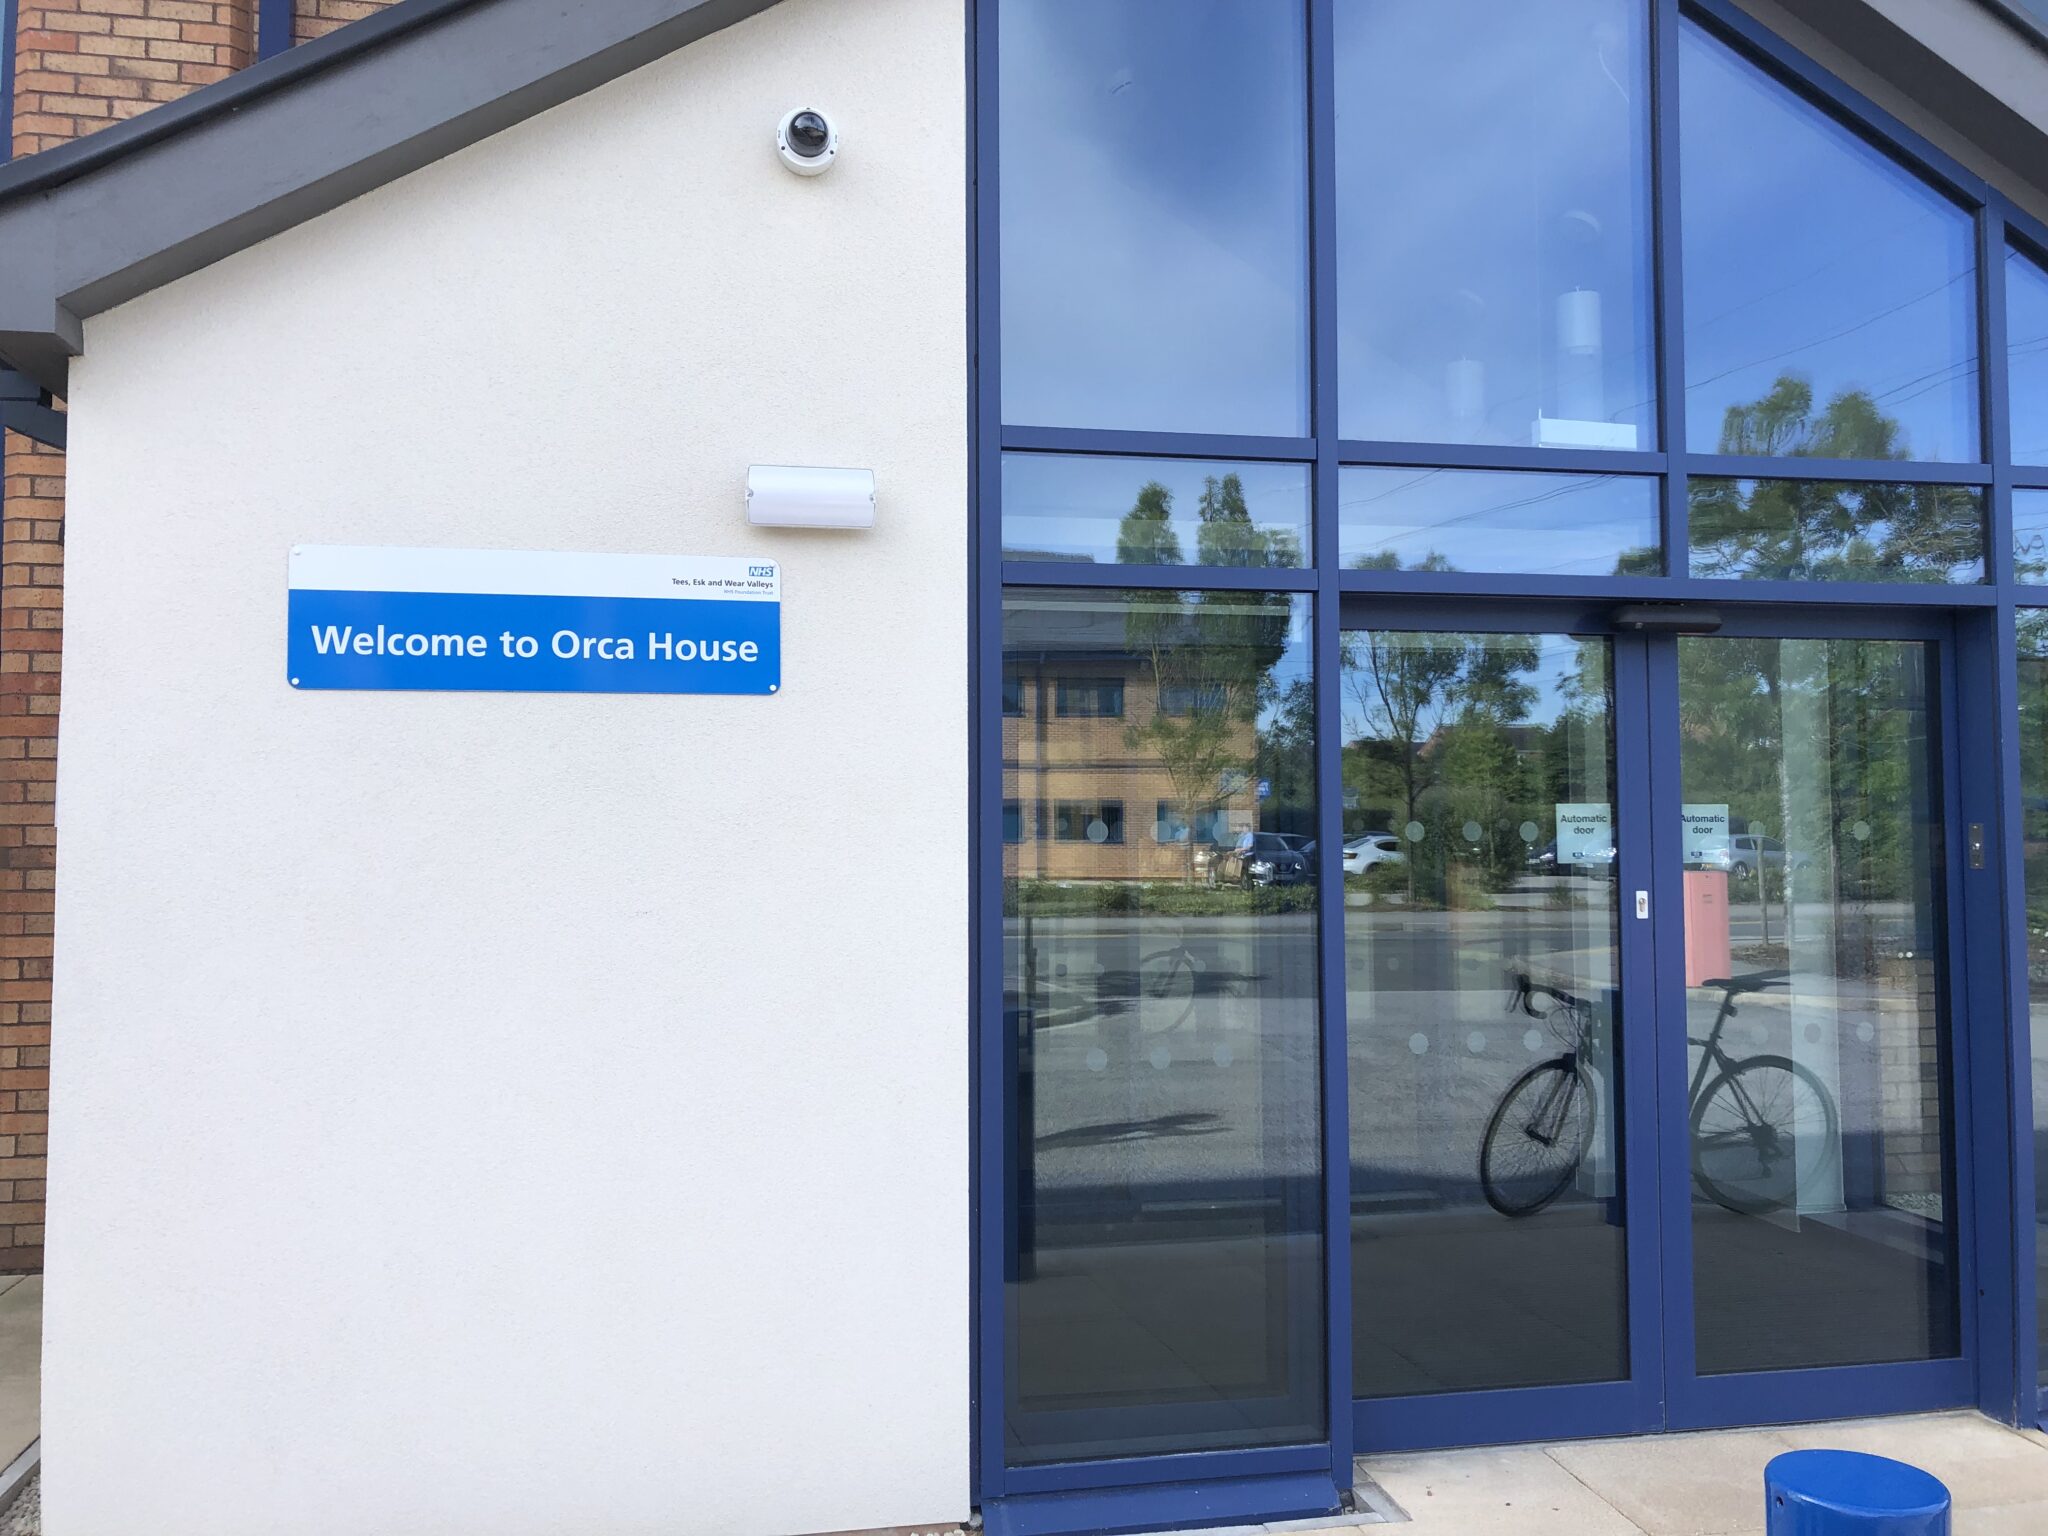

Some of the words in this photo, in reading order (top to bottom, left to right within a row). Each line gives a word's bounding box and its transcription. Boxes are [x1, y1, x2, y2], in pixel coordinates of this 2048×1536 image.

[749, 567, 773, 577] NHS
[672, 578, 691, 586] Tees,
[692, 578, 706, 586] Esk
[707, 579, 722, 587] and
[747, 580, 774, 589] Valleys
[311, 624, 488, 658] Welcome
[499, 631, 539, 659] to
[551, 629, 635, 660] Orca
[648, 632, 759, 662] House
[1560, 815, 1608, 823] Automatic
[1573, 826, 1595, 834] door
[1692, 825, 1714, 834] door
